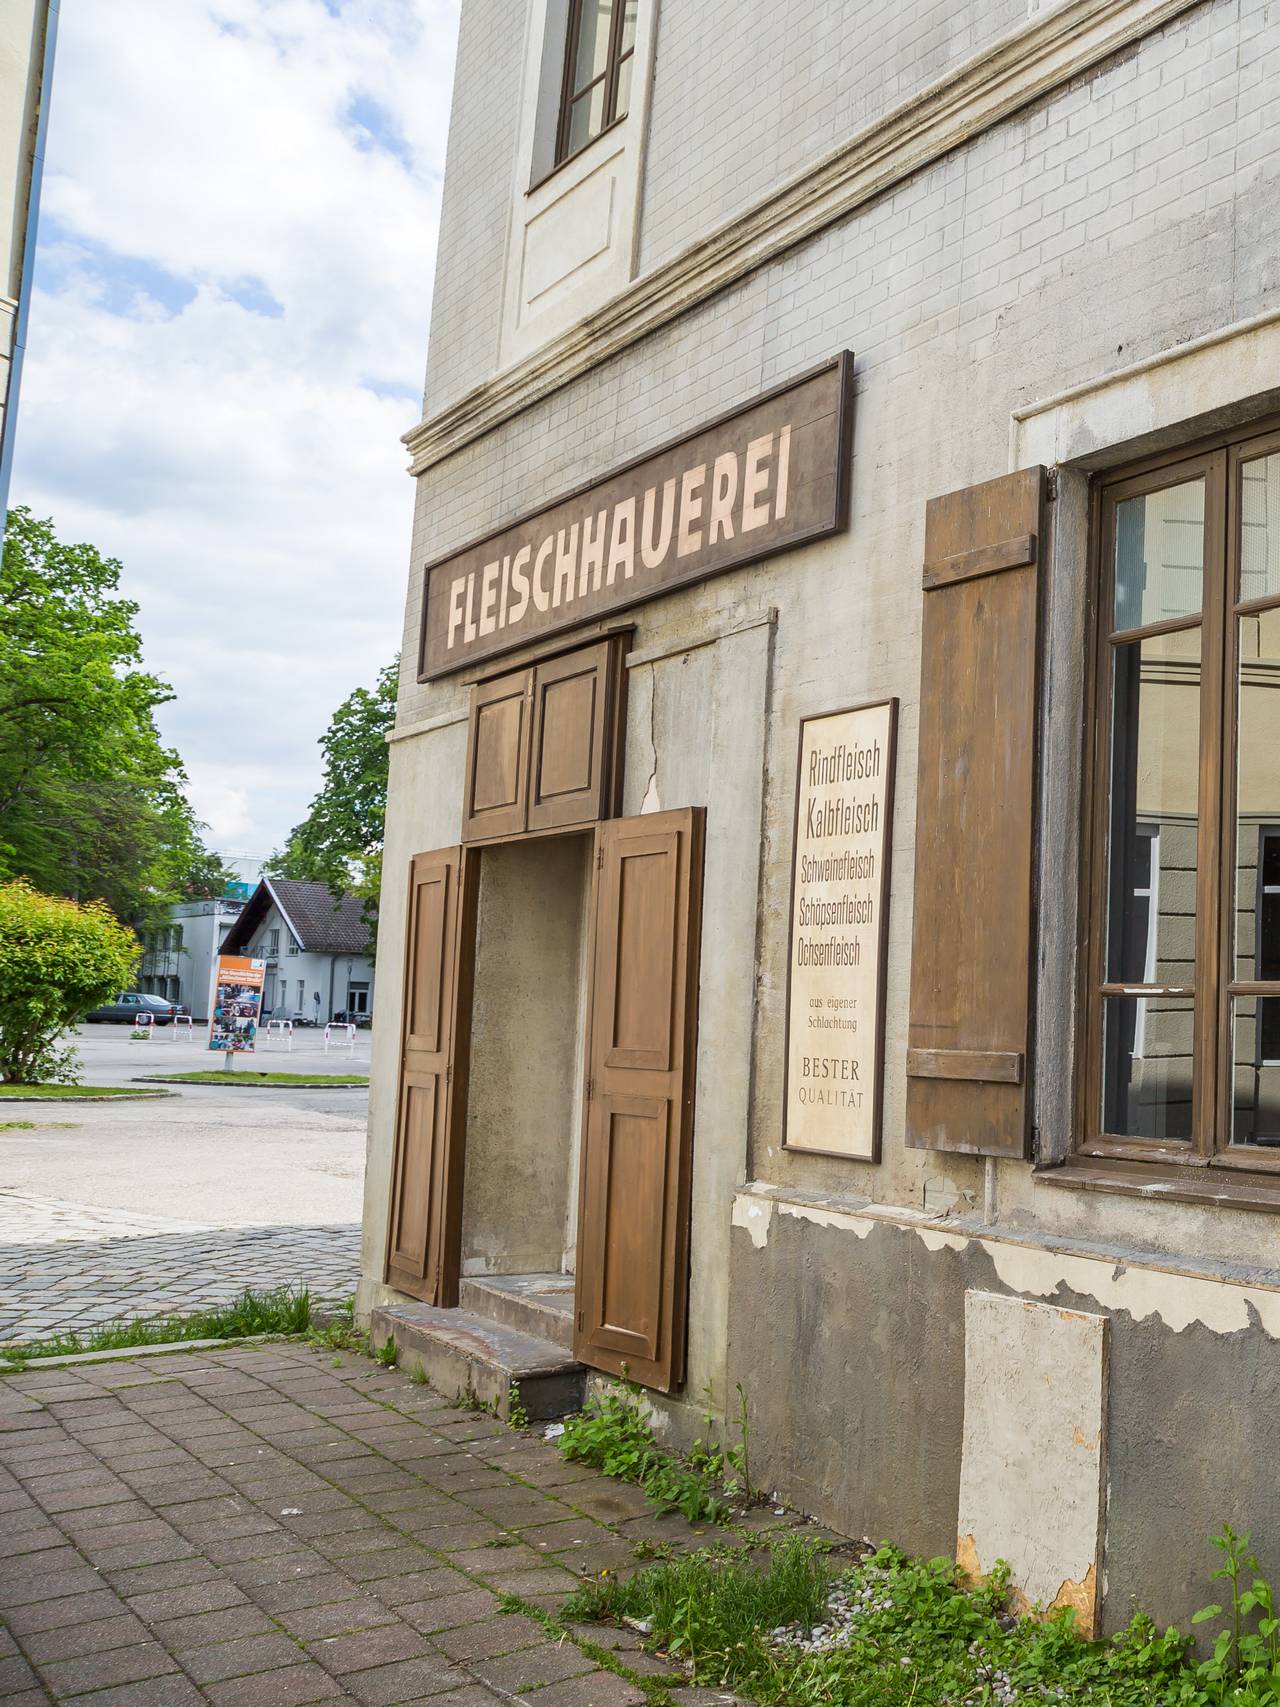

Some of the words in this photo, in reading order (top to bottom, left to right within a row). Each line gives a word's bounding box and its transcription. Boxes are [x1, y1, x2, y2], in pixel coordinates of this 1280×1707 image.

[447, 424, 791, 650] FLEISCHHAUEREI
[809, 739, 880, 787] Rindfleisch
[806, 793, 878, 839] Kalbfleisch
[801, 848, 874, 884] Schweinefleisch
[799, 893, 873, 930] Schöpsenfleisch
[797, 935, 860, 967] Ochsenfleisch
[809, 998, 823, 1009] aus
[827, 996, 857, 1014] eigener
[808, 1015, 857, 1032] Schlachtung
[802, 1057, 860, 1081] BESTER
[798, 1087, 864, 1109] QUALITÄT
